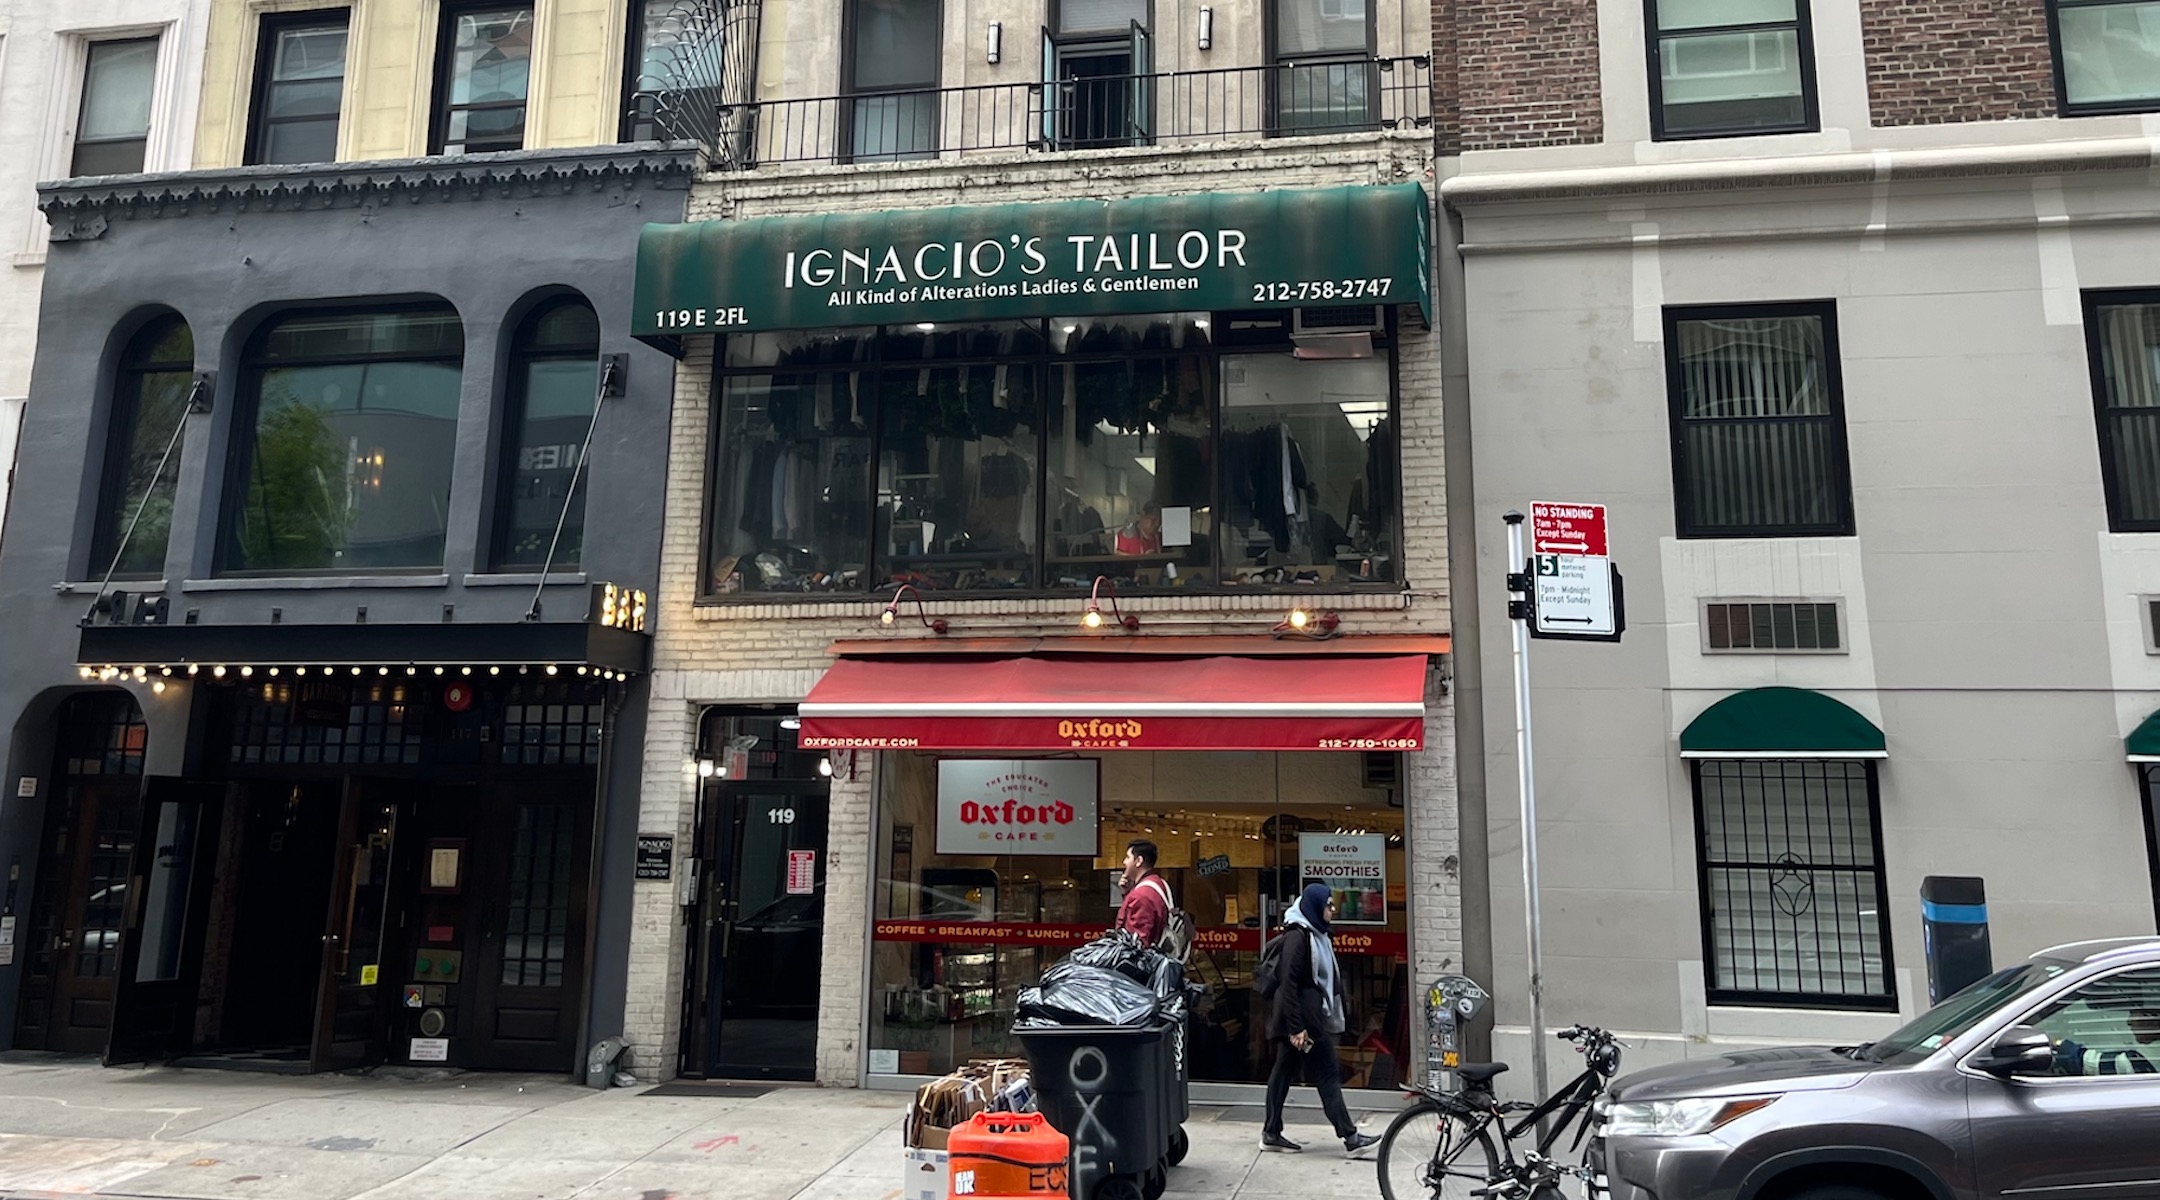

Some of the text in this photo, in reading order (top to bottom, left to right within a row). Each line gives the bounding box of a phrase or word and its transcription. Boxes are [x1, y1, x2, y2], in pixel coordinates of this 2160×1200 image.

[784, 229, 1247, 289] IGNACIO'S TAILOR
[827, 275, 1199, 307] All Kind of Alterations Ladies & Gentlemen
[1253, 277, 1393, 302] 212-758-2747
[655, 307, 748, 328] 119 E 2FL
[1535, 506, 1594, 520] NO STANDING
[1536, 518, 1551, 528] 7am
[1556, 519, 1572, 530] 7pm
[1536, 528, 1586, 541] Except Sunday
[1541, 555, 1554, 575] 5
[1541, 585, 1556, 594] 7pm
[1561, 585, 1591, 595] Midnight
[602, 581, 647, 631] BAR
[1540, 594, 1591, 605] Except Sunday
[1058, 718, 1142, 738] Oxford
[803, 737, 918, 747] OXFORDCAFE.COM
[1318, 739, 1417, 749] 212-750-1060
[985, 773, 1049, 788] THE EDUCATED
[1001, 784, 1033, 793] CHOICE
[768, 808, 796, 824] 119
[960, 798, 1074, 825] Oxford
[994, 832, 1038, 841] CAFE
[1323, 845, 1358, 853] Oxford
[1198, 860, 1229, 875] CLOSED
[1304, 865, 1380, 877] SMOOTHIES
[877, 925, 926, 935] COFFEE
[939, 926, 1012, 937] BREAKFAST
[1027, 929, 1070, 939] LUNCH
[1332, 934, 1372, 946] xford
[955, 1180, 976, 1195] UK
